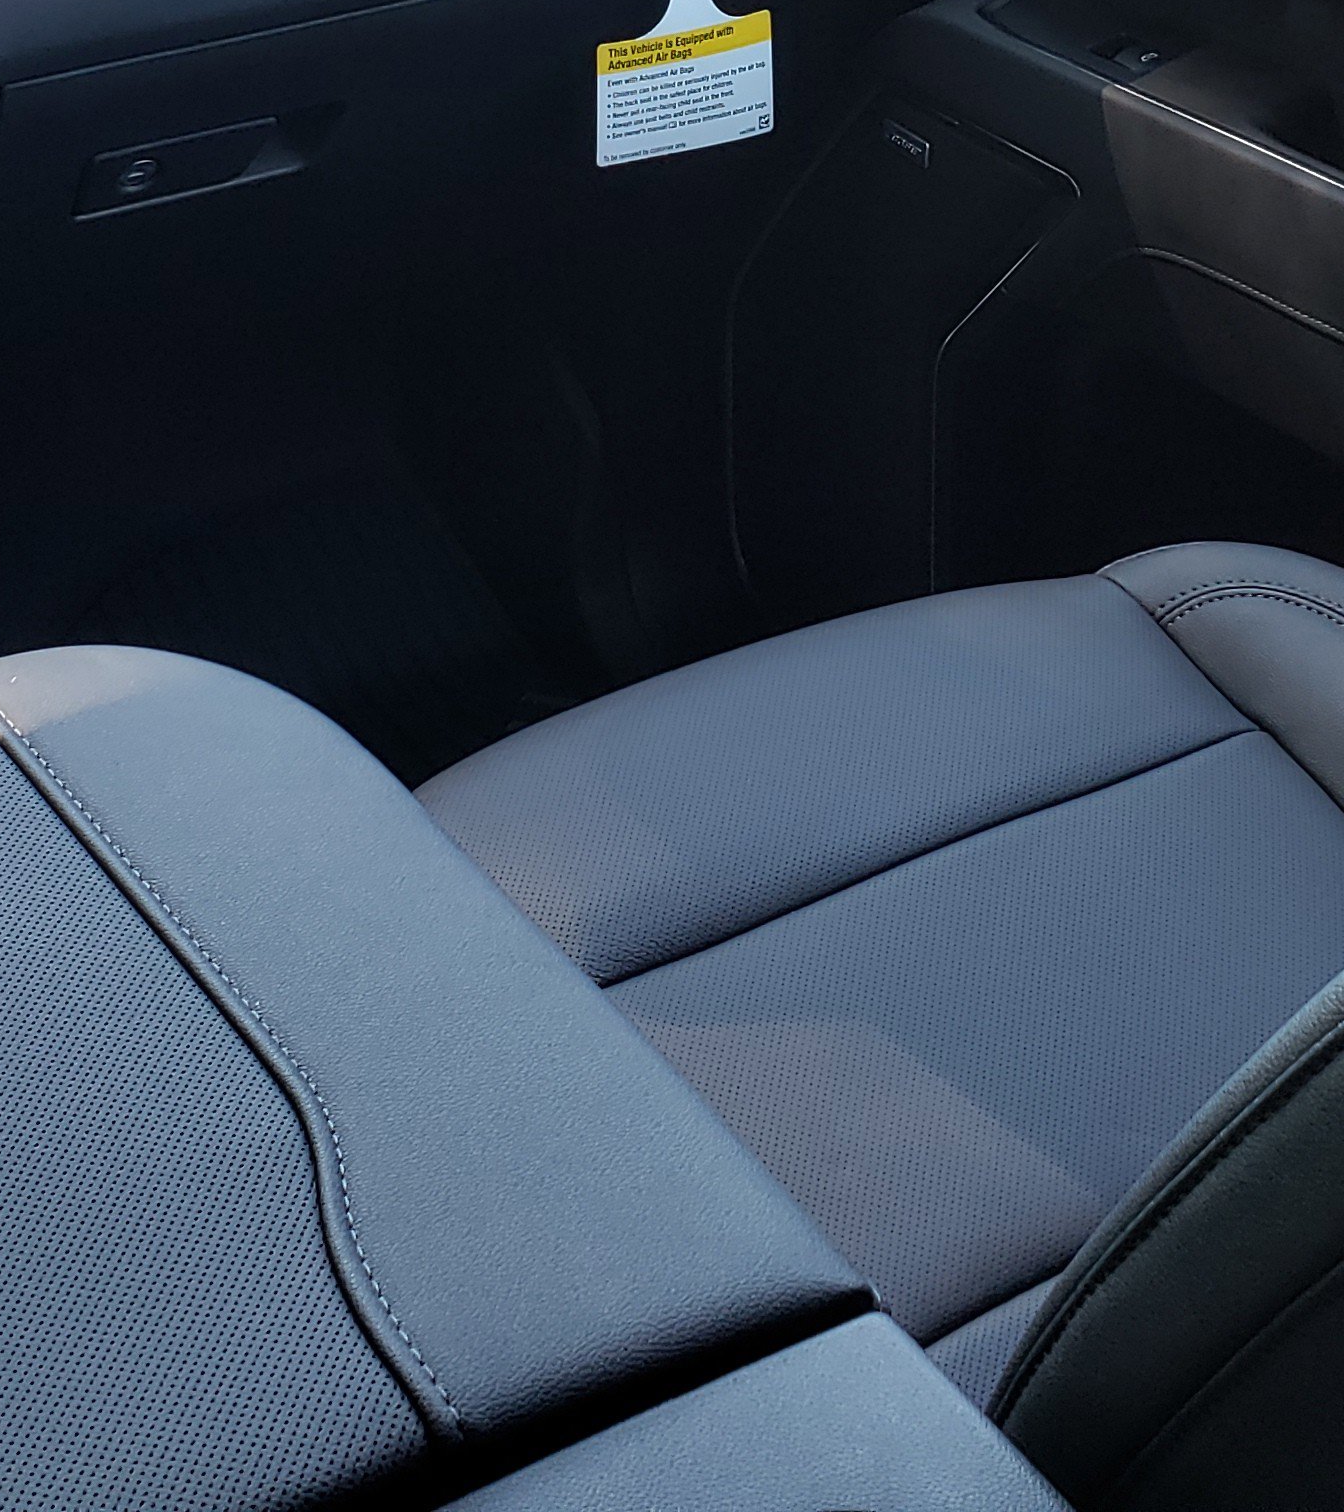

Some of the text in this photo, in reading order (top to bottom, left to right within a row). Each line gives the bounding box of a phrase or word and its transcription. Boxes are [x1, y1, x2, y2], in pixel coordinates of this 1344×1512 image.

[608, 48, 628, 58] This
[631, 42, 663, 55] Vehicle
[675, 29, 715, 47] Equipped
[716, 26, 734, 38] with
[608, 48, 693, 71] Advanced Air Bags
